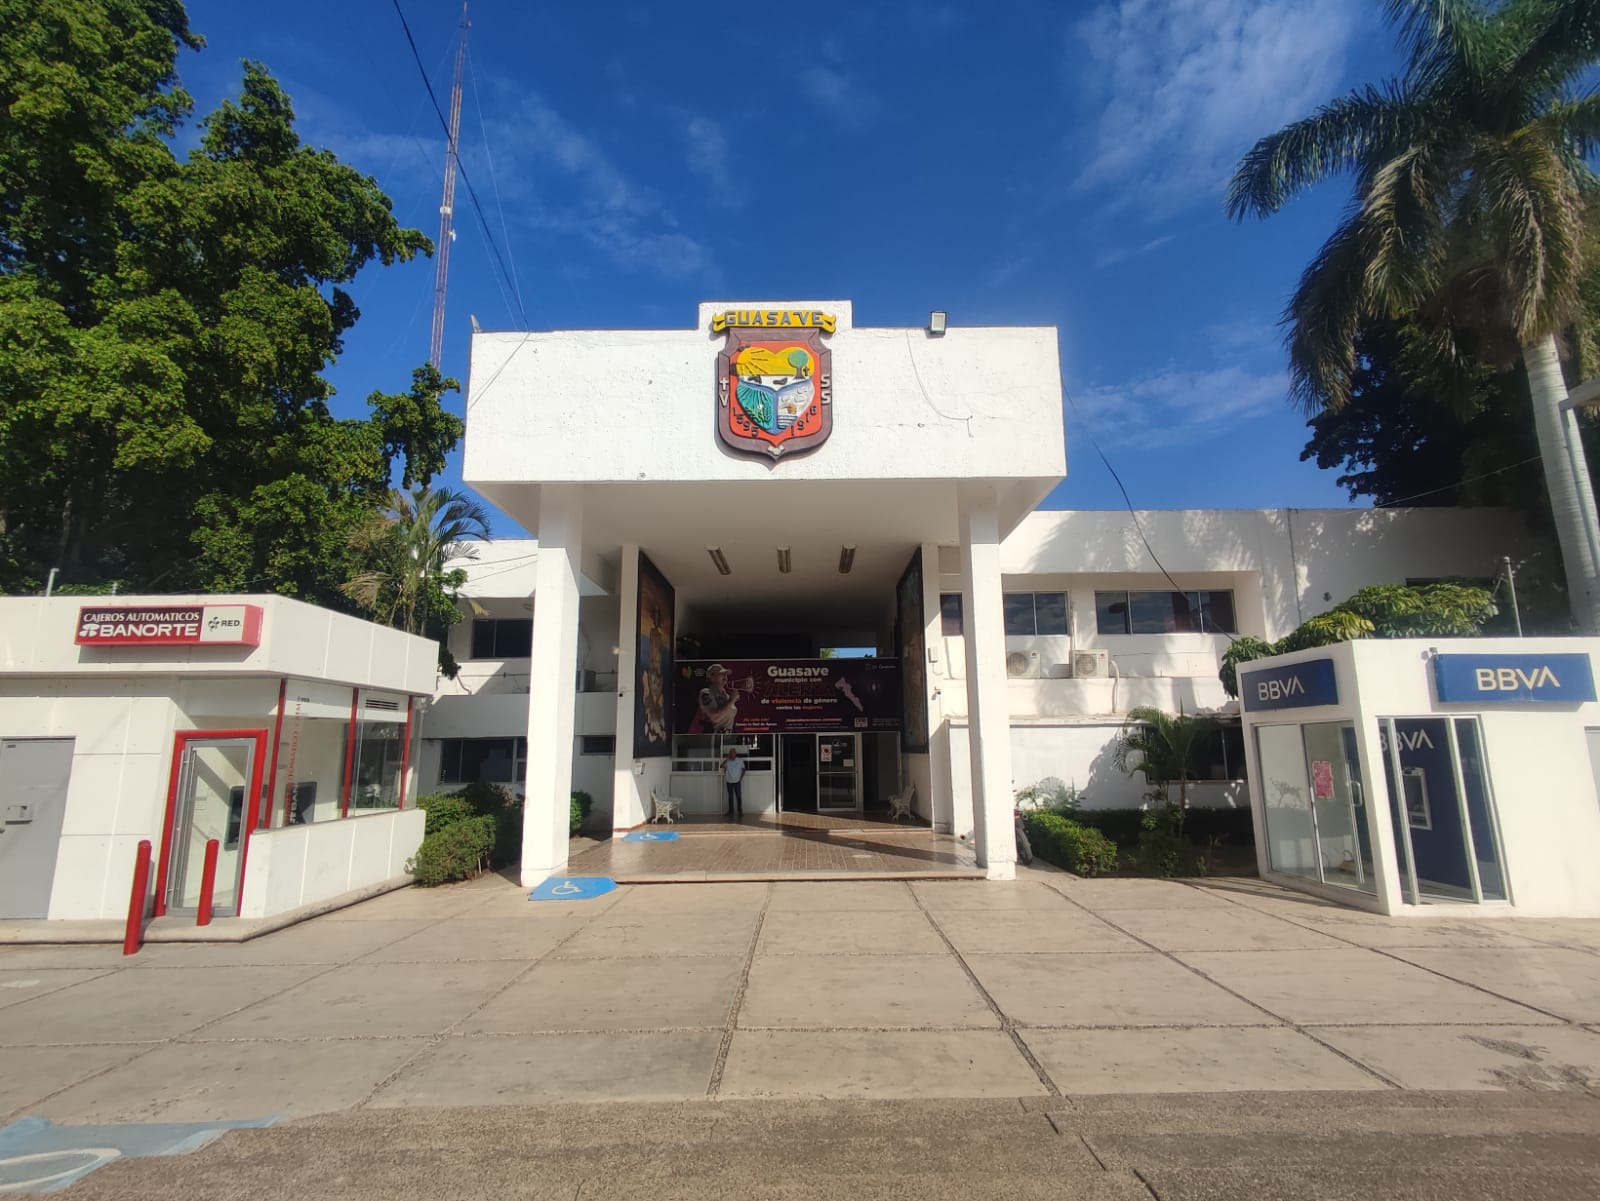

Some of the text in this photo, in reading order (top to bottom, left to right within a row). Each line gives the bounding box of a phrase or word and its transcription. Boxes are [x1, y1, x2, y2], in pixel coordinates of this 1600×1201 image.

[724, 310, 824, 325] GUASAVE
[83, 611, 200, 622] CAJEROS AUTOMATICOS
[99, 623, 199, 638] BANORTE
[767, 665, 829, 677] Guasave
[1475, 665, 1561, 691] BBVA
[1258, 675, 1305, 702] BBVA
